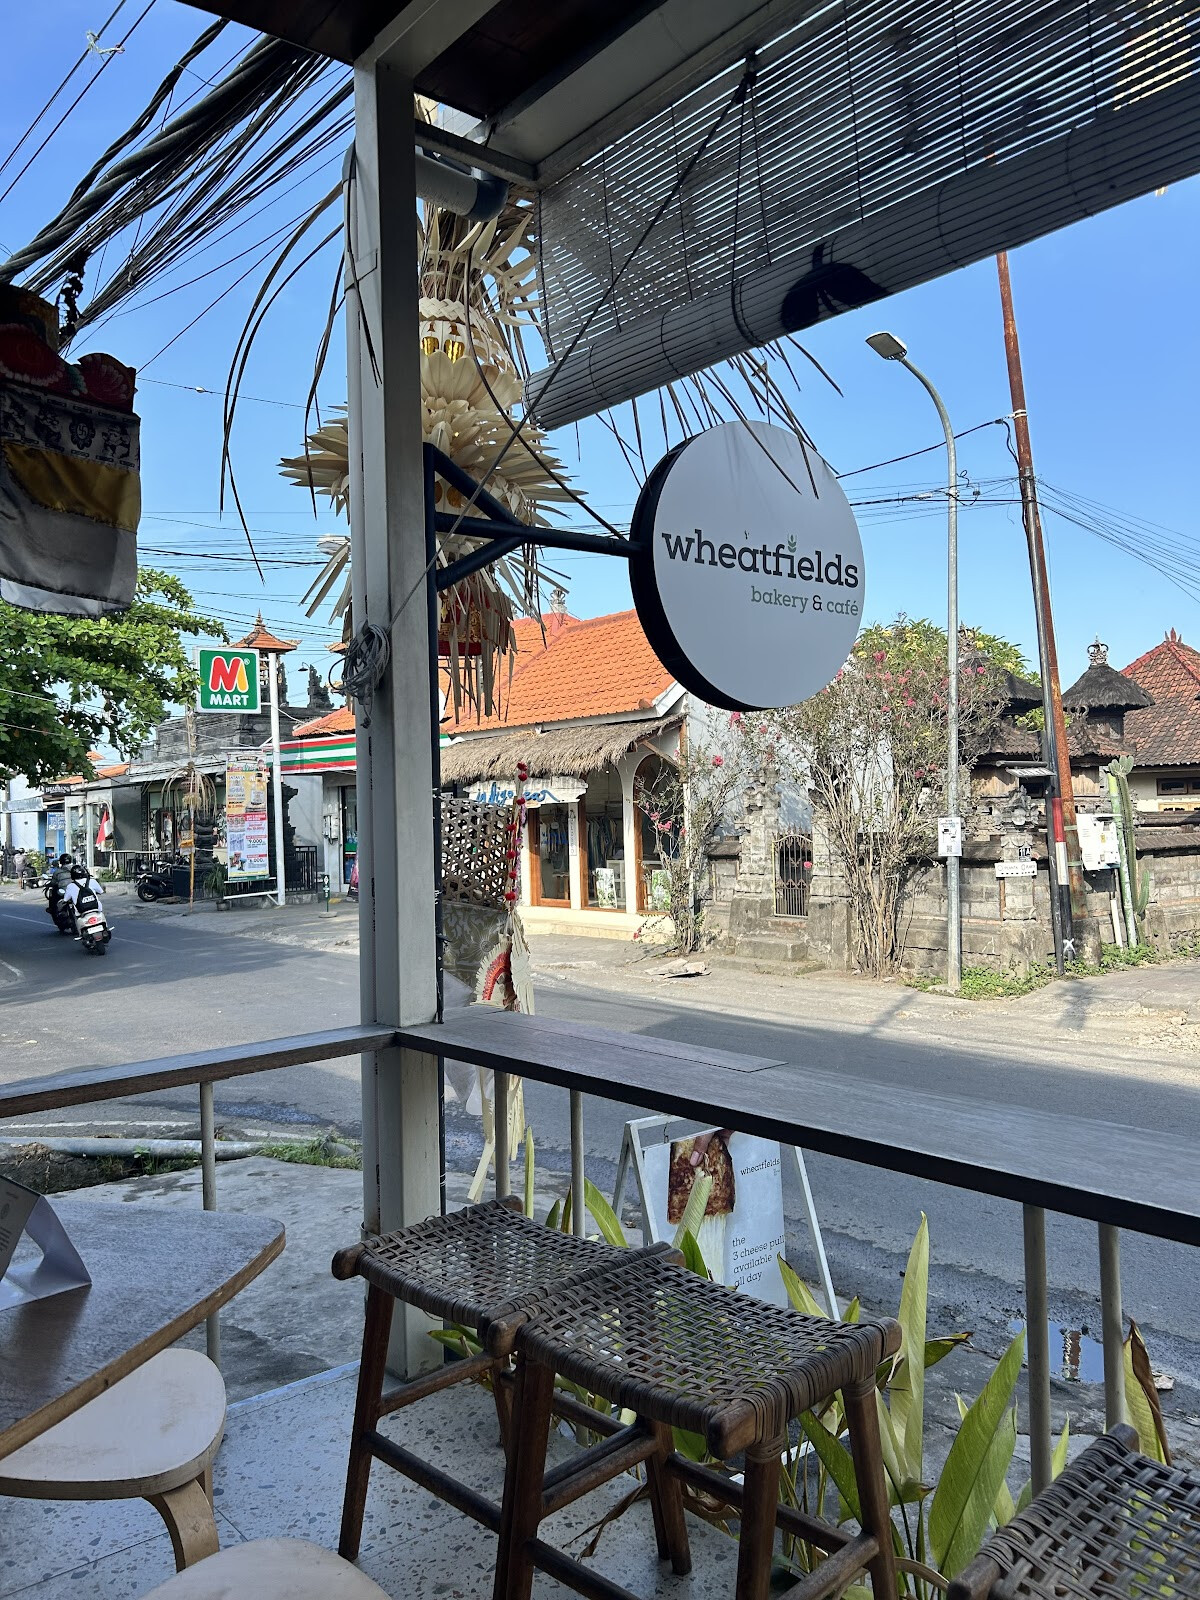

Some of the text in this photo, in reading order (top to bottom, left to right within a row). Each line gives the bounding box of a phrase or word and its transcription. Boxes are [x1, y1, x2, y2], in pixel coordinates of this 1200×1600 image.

[661, 528, 859, 588] wheatfields
[751, 586, 859, 616] bakery & café
[209, 693, 249, 706] MART
[740, 1158, 780, 1175] wheatfields
[732, 1237, 746, 1248] the
[732, 1234, 785, 1261] 3 cheese pull
[733, 1254, 773, 1274] available
[734, 1271, 763, 1288] all day
